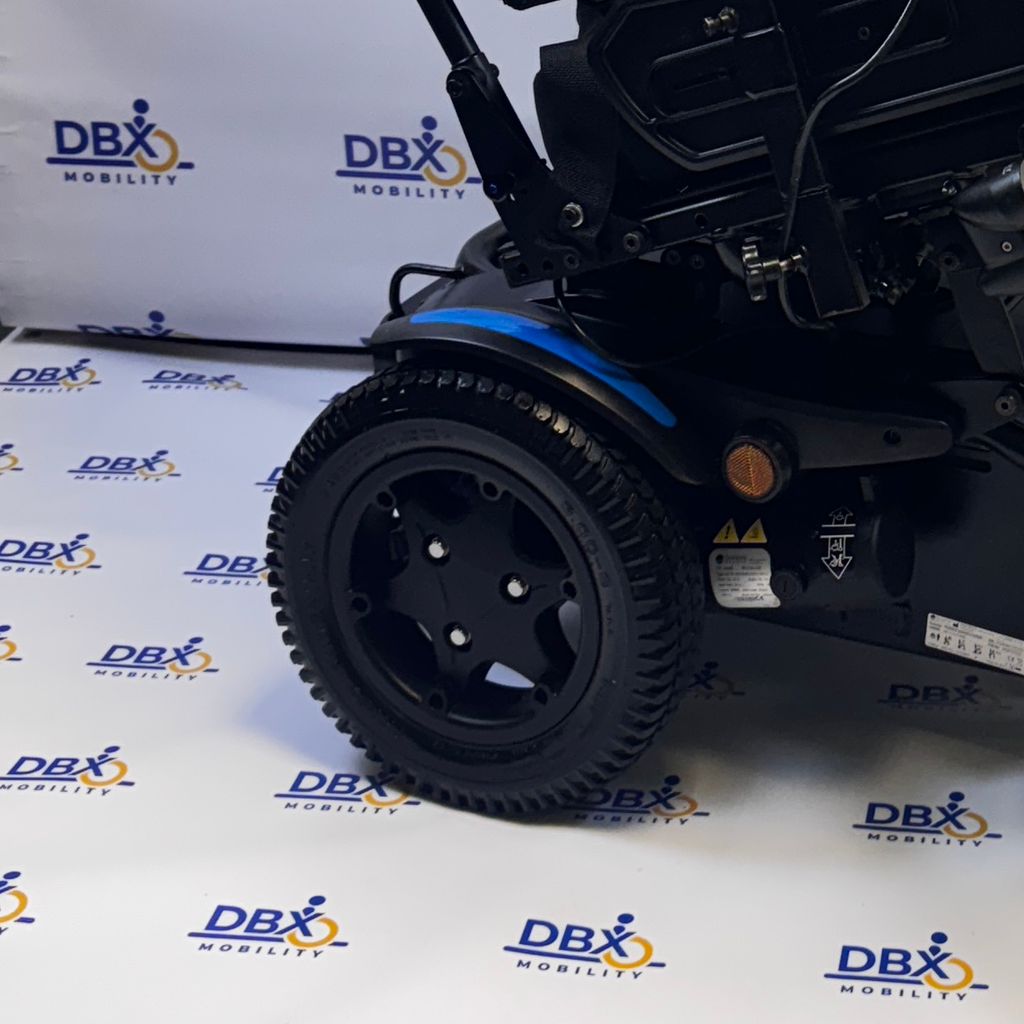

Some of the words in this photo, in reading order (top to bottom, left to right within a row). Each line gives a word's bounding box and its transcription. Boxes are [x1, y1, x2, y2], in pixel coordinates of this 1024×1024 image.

[54, 115, 158, 158] DBX
[344, 132, 446, 172] DBX
[64, 172, 176, 185] MOBILITY
[354, 184, 464, 199] MOBILITY
[8, 366, 83, 383] DBX
[155, 369, 229, 385] DBX
[80, 455, 160, 472] DBX
[0, 539, 82, 561] DBX
[2, 566, 80, 575] OBILITY
[197, 553, 268, 574] DB
[191, 578, 262, 586] MOBILI
[100, 643, 204, 665] DBX
[95, 670, 196, 680] MOBILITY
[888, 683, 981, 704] DBX
[7, 754, 115, 776] DBX
[0, 785, 110, 795] MOBILITY
[285, 803, 397, 814] MOBILITY
[865, 801, 969, 830] DBX
[868, 833, 981, 846] MOBILITY
[206, 903, 324, 939] DBX
[518, 918, 634, 958] DBX
[199, 944, 323, 957] MOBILITY
[517, 960, 641, 979] MOBILITY
[838, 946, 952, 980] DBX
[841, 985, 966, 1000] MOBILITY
